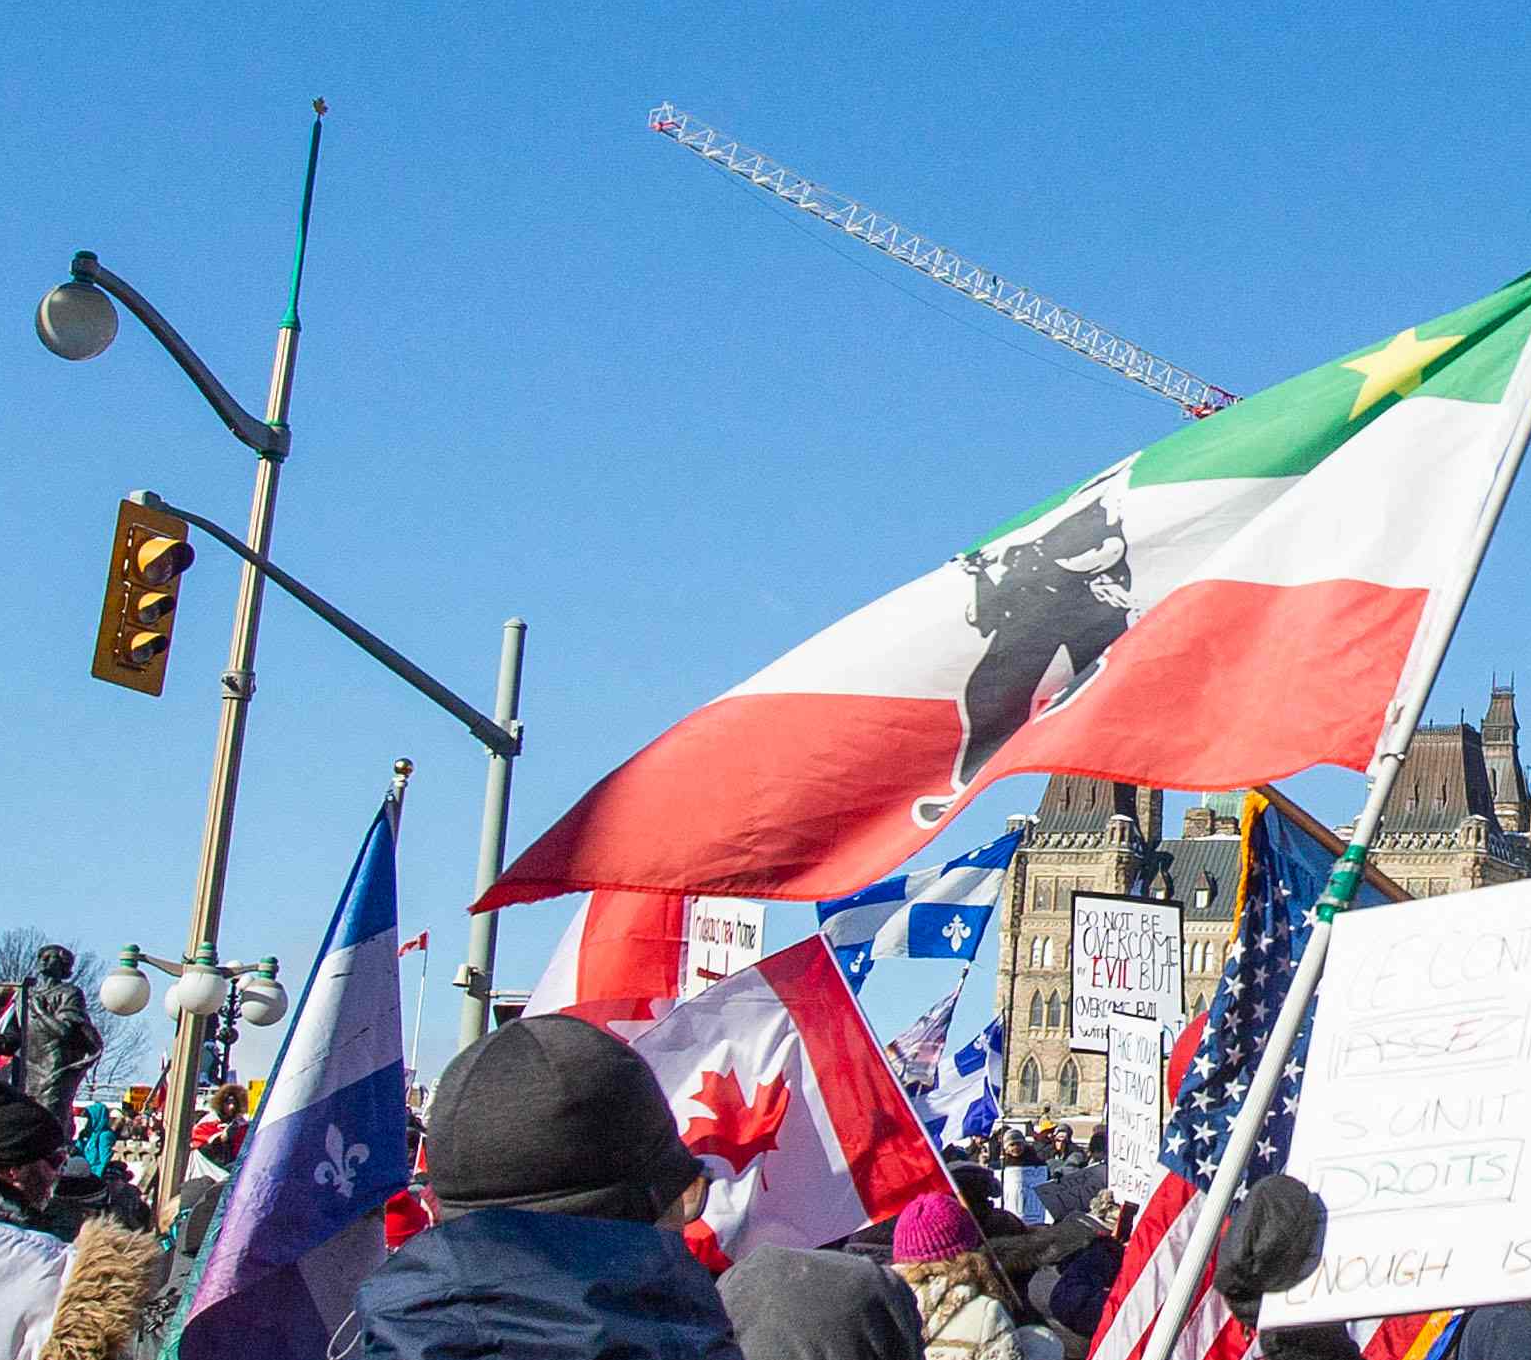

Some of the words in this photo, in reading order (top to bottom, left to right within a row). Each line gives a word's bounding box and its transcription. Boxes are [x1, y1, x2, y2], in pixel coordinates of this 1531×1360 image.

[736, 913, 756, 949] home
[1077, 910, 1098, 927] DO
[1104, 912, 1133, 930] NOT
[1141, 914, 1162, 934] BE
[1083, 927, 1178, 966] OVERCOME
[1092, 955, 1132, 990] EVIL
[1140, 960, 1169, 993] BUT
[1111, 1028, 1132, 1061] TAKE
[1111, 1066, 1156, 1105] STAND
[1317, 1153, 1509, 1211] DROITS
